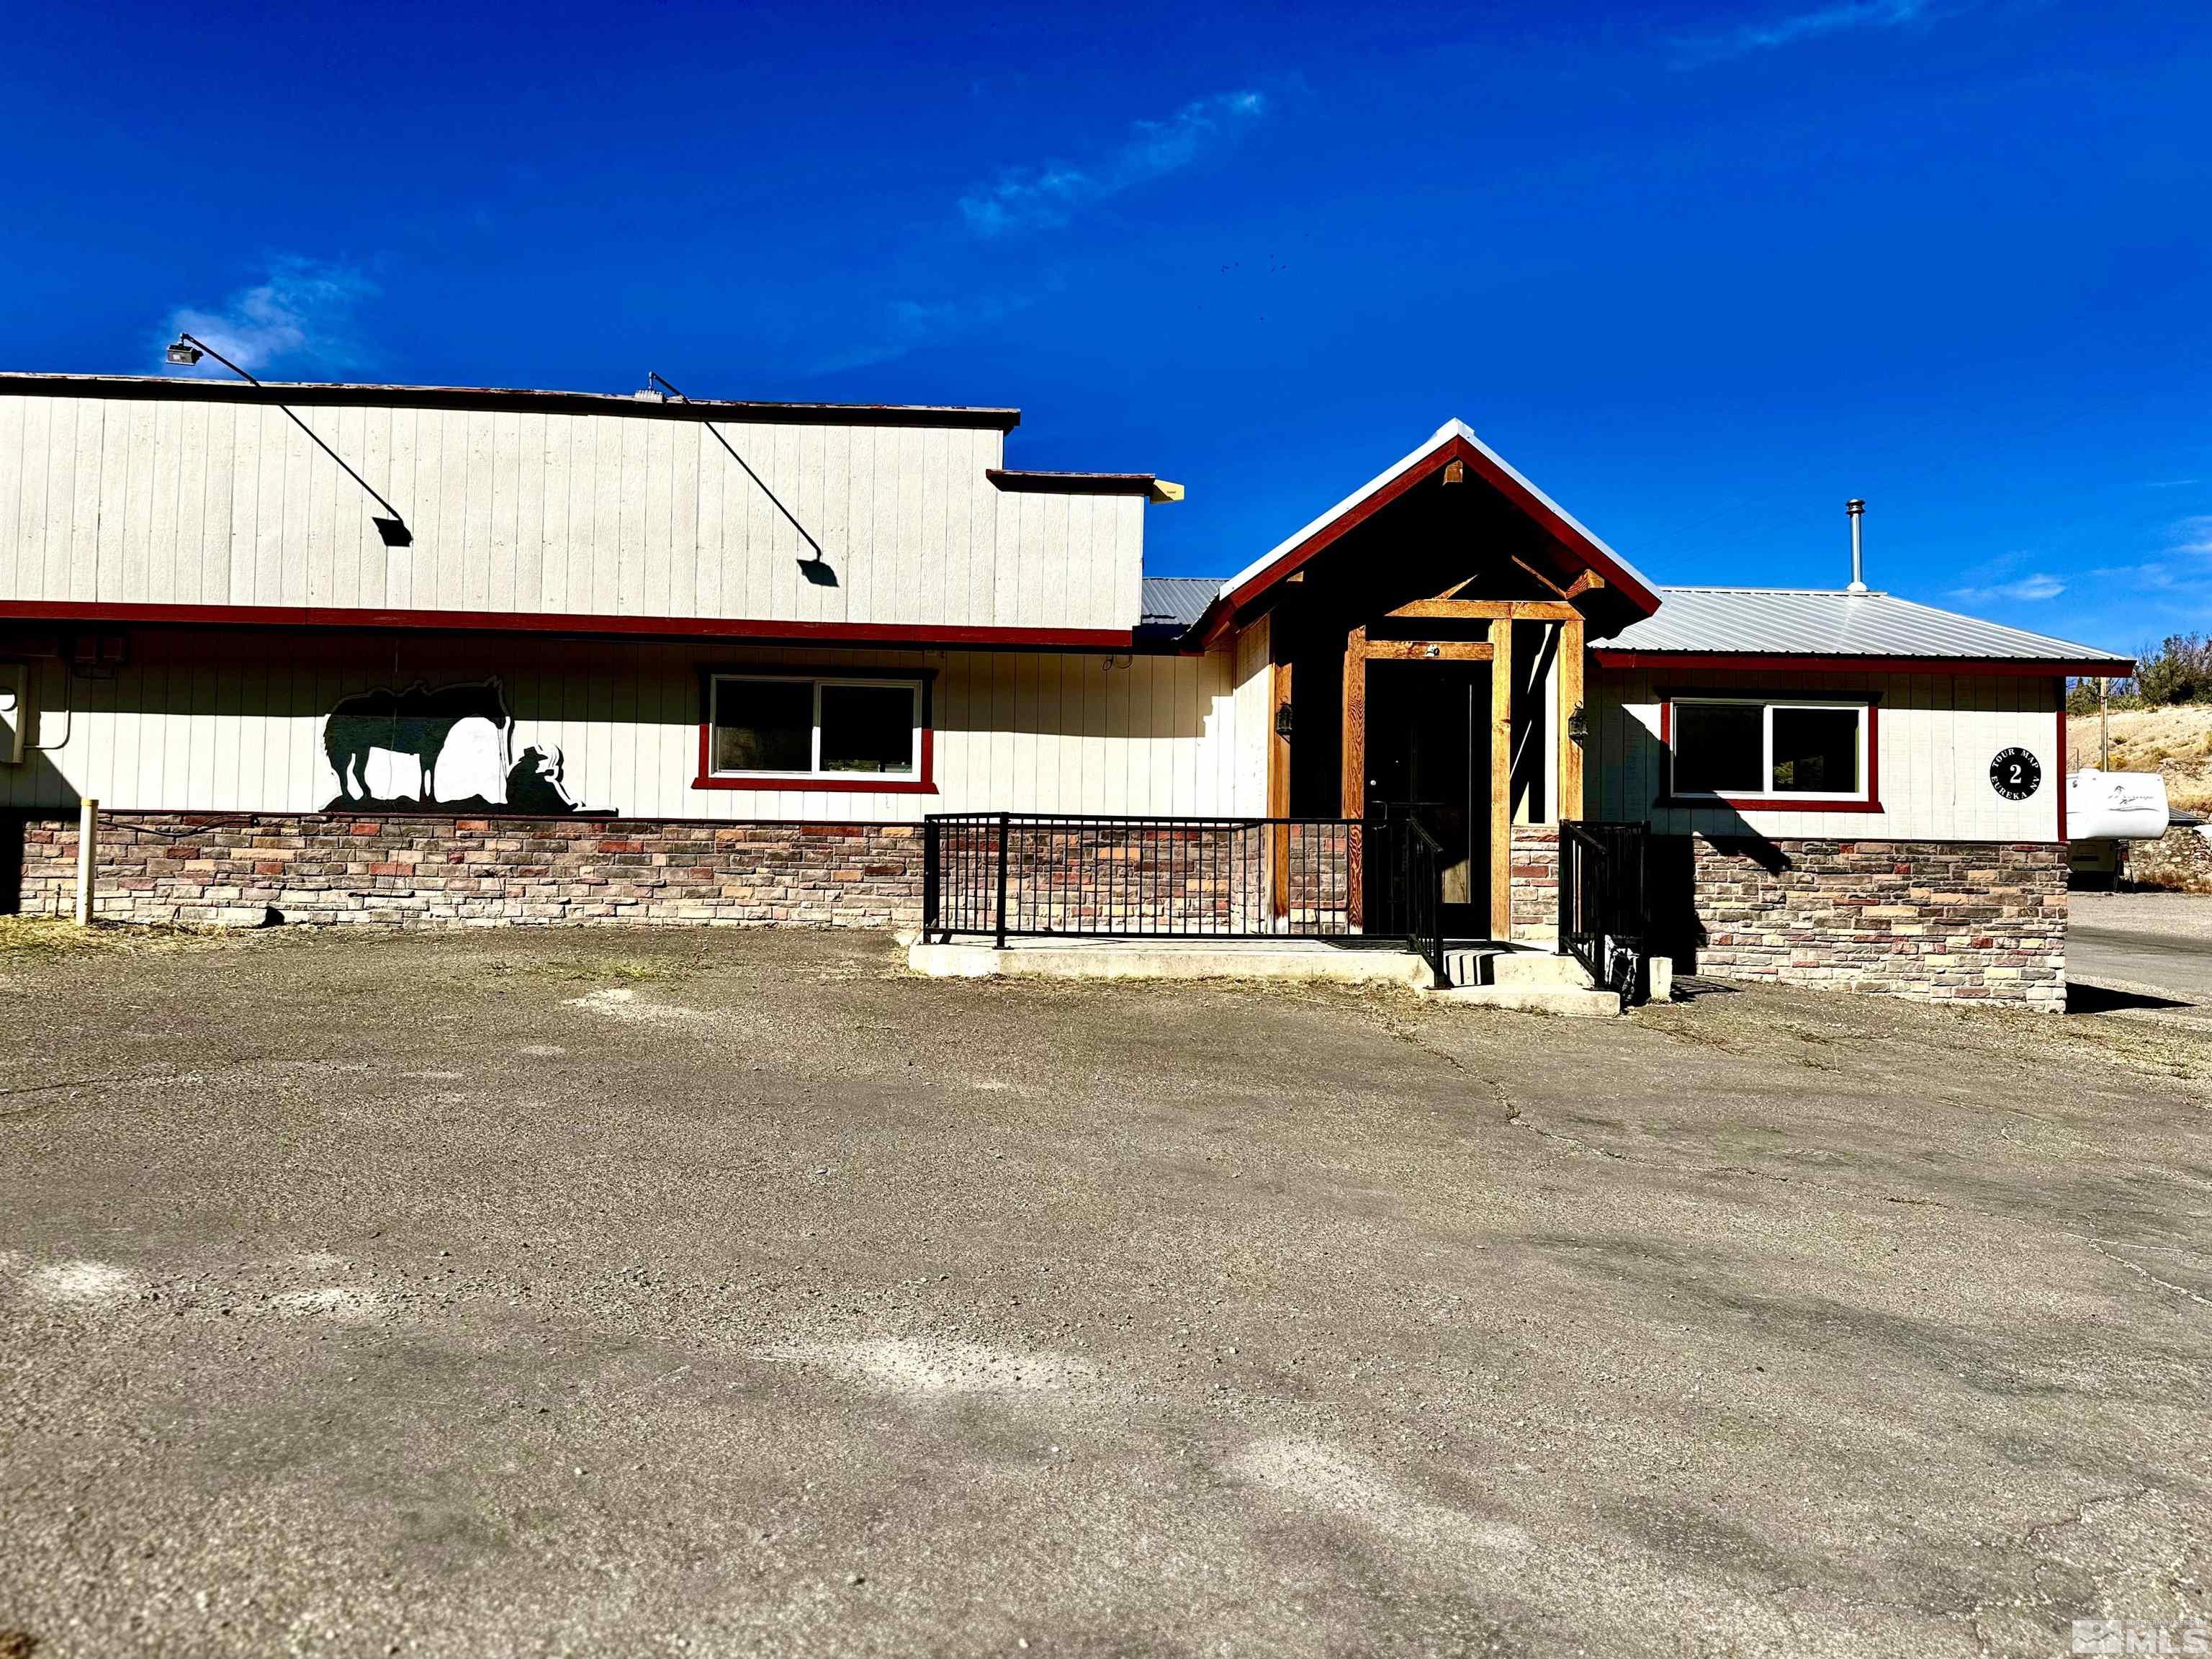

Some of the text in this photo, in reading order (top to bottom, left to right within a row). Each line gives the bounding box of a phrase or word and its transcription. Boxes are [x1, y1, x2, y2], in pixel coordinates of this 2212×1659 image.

[1992, 749, 2039, 768] TOUR MAP
[2010, 764, 2022, 783] 2
[1991, 775, 2039, 800] EUREKA NV
